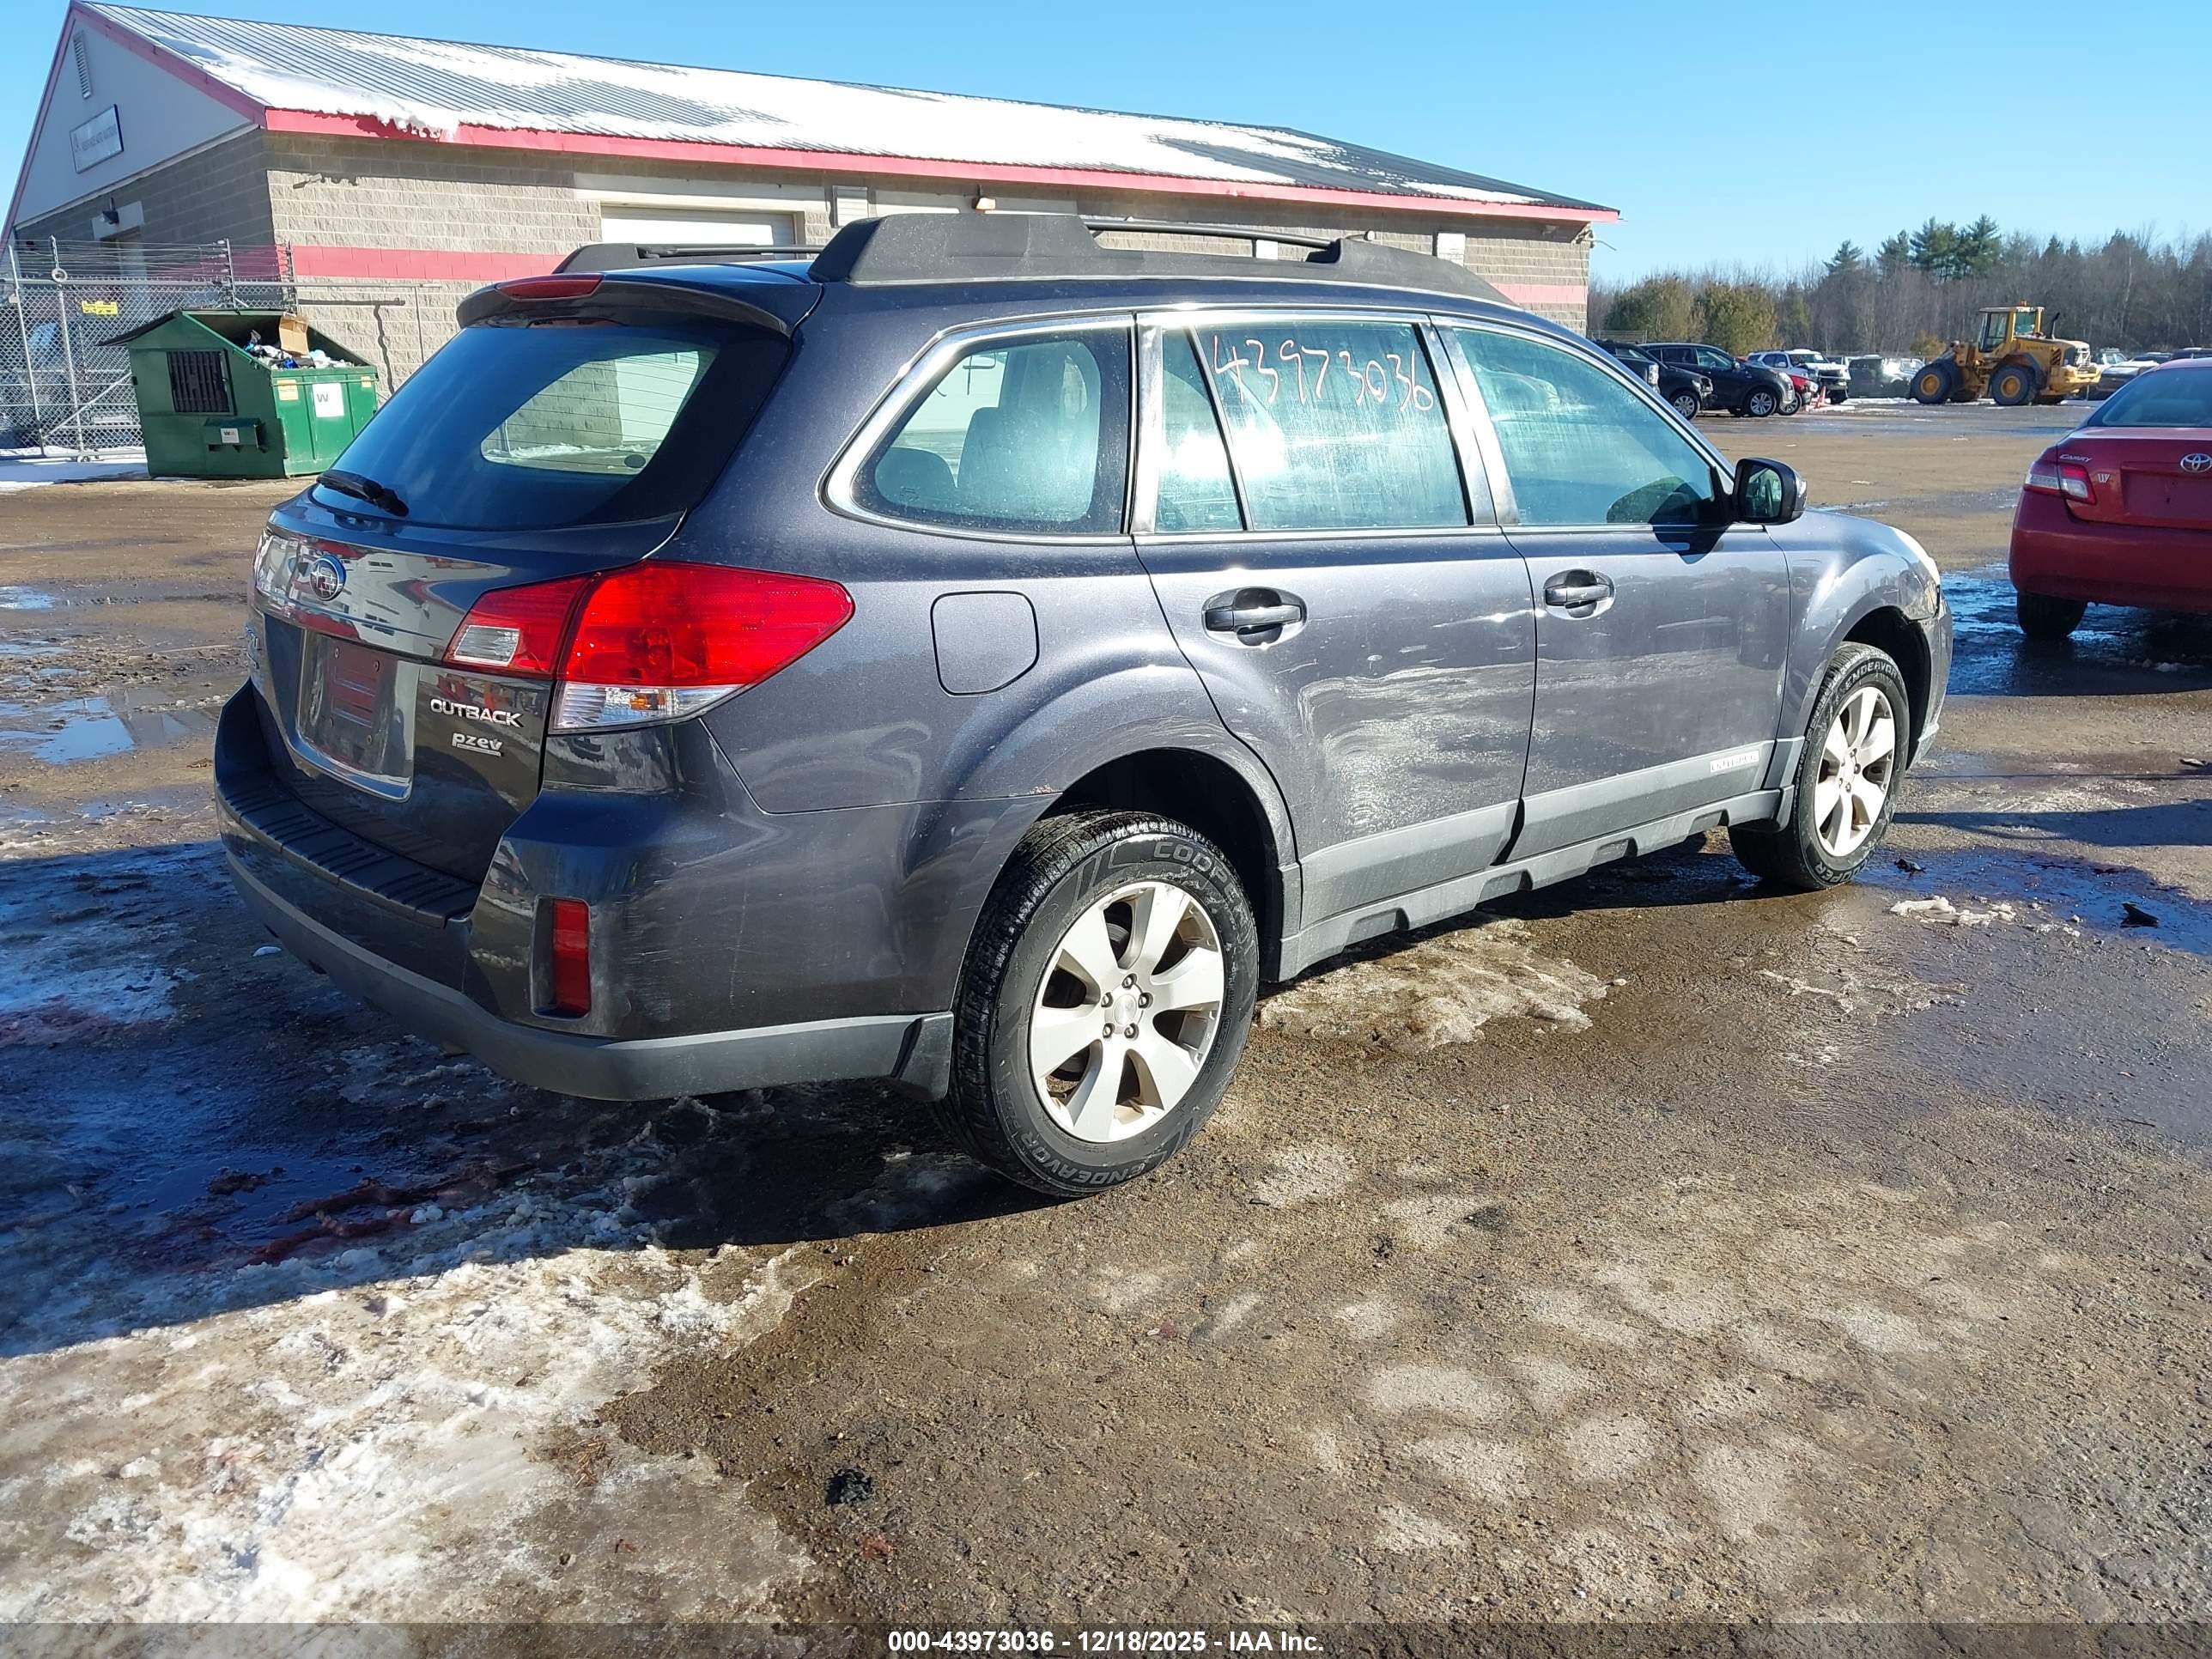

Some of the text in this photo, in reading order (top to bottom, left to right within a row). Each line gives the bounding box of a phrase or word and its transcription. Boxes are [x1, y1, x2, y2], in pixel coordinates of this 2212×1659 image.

[1212, 335, 1434, 412] 43973036
[1844, 660, 1899, 690] ENDEAVOR
[430, 698, 523, 728] OUTBACK
[1153, 841, 1249, 928] COOPER
[1019, 1132, 1146, 1186] ENDEAVOR
